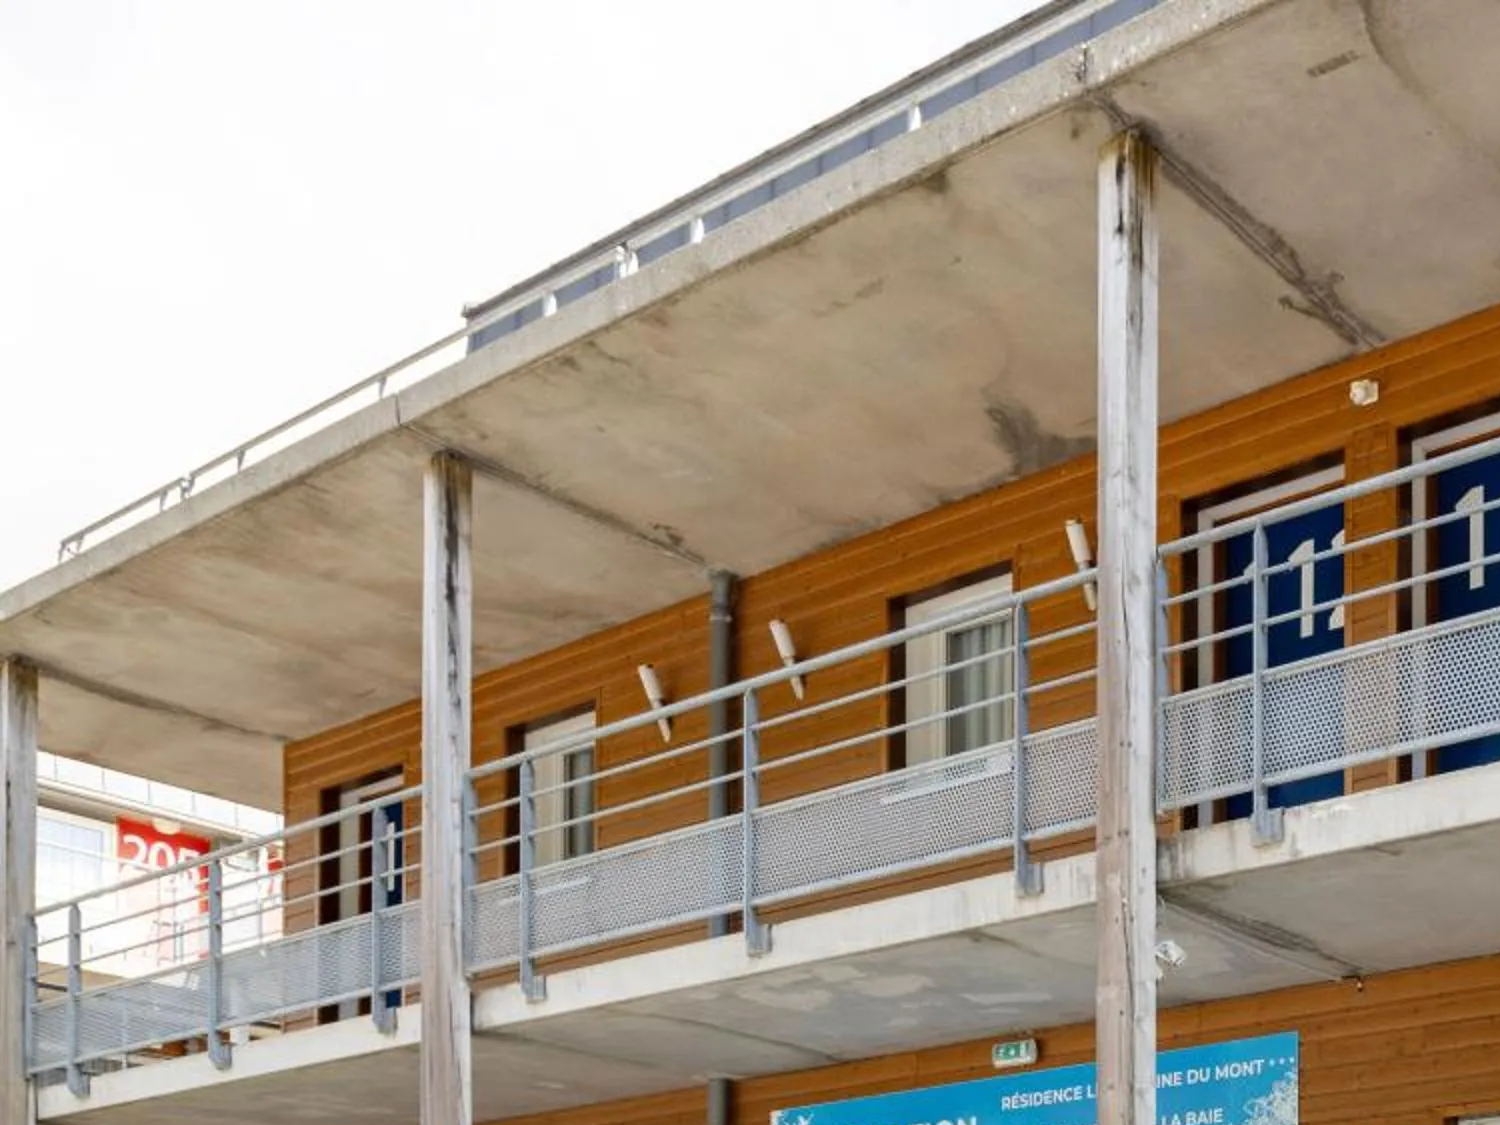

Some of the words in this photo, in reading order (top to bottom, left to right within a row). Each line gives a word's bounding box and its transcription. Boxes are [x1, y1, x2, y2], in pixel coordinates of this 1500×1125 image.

[1001, 1085, 1083, 1111] RÉSIDENCE
[1087, 1083, 1098, 1099] L
[1156, 1072, 1181, 1089] INE
[1187, 1067, 1210, 1083] DU
[1215, 1059, 1265, 1079] MONT
